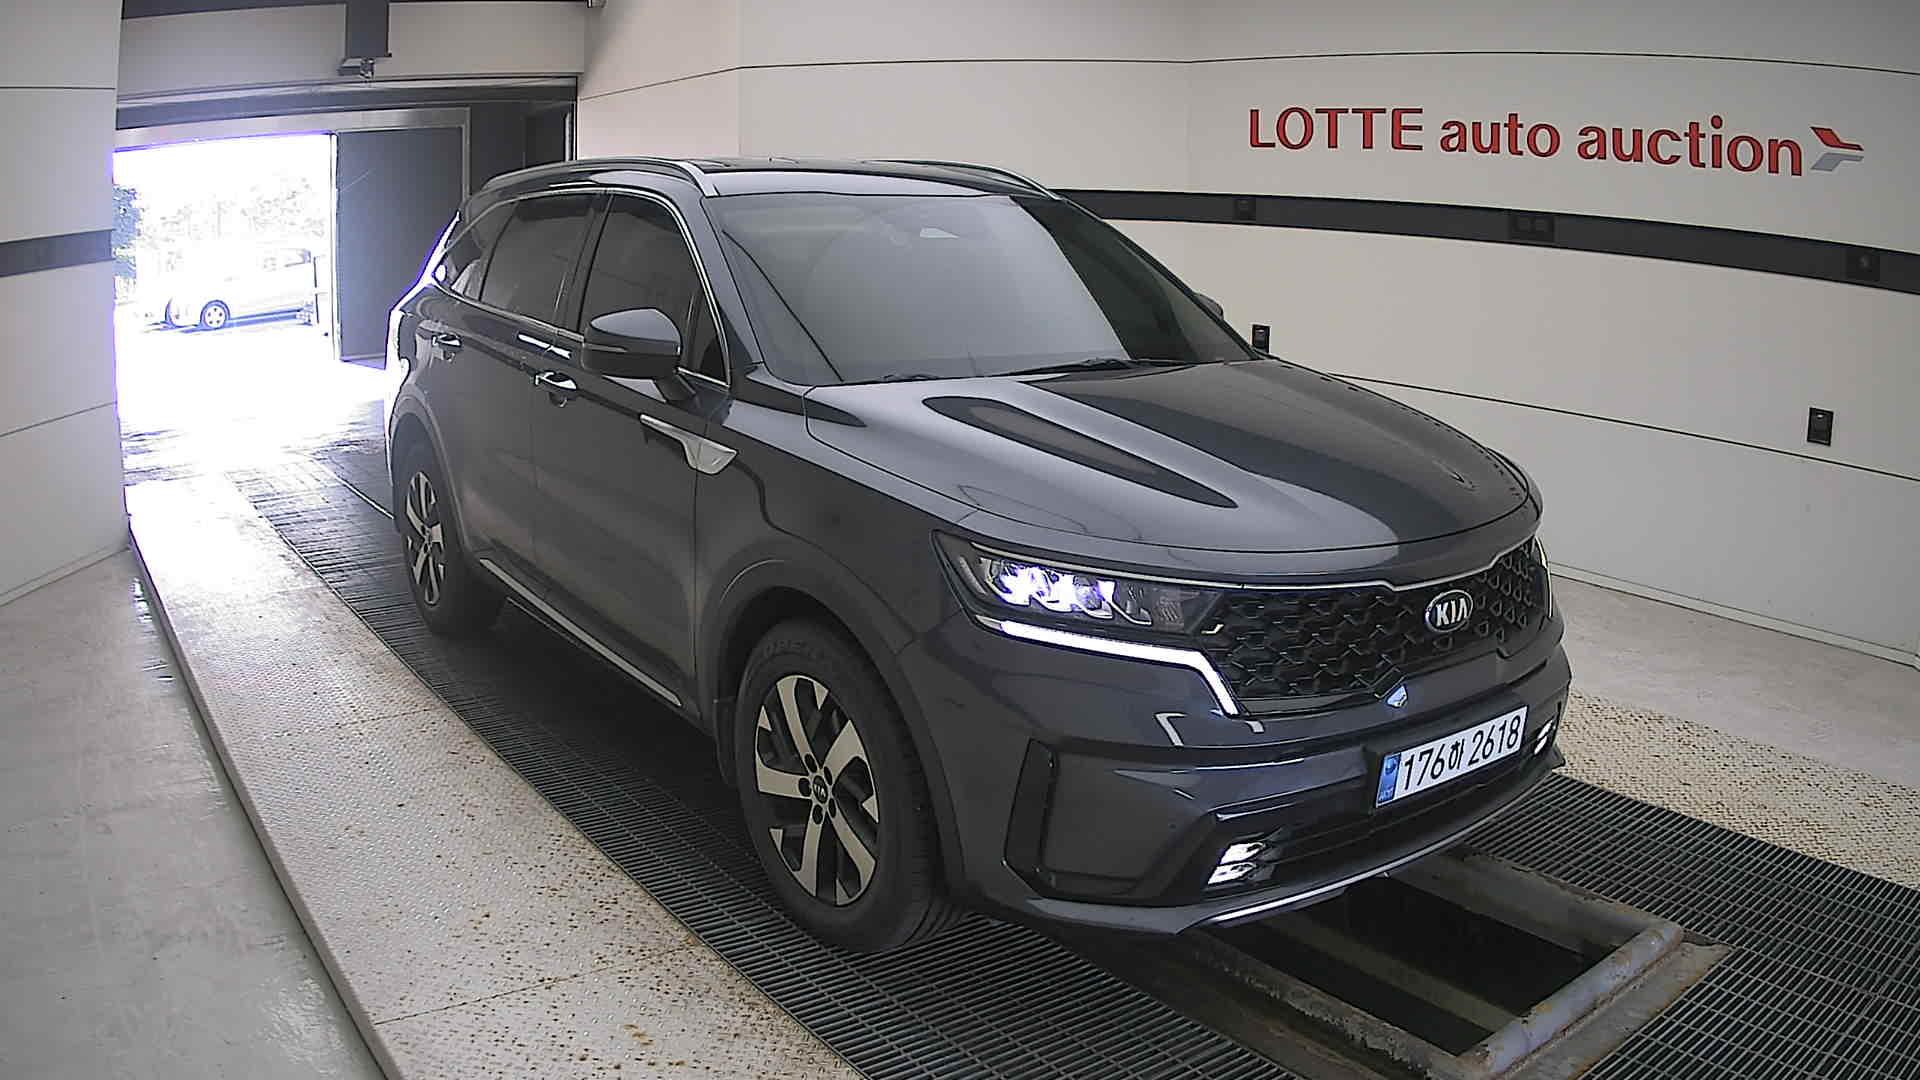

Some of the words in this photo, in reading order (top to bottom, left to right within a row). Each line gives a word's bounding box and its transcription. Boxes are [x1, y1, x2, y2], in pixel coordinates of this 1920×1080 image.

[1249, 106, 1424, 151] LOTTE
[1439, 112, 1561, 158] auto
[1576, 114, 1804, 177] auction
[1434, 597, 1468, 628] KIA
[1404, 738, 1465, 791] 176하
[1468, 714, 1521, 766] 2618
